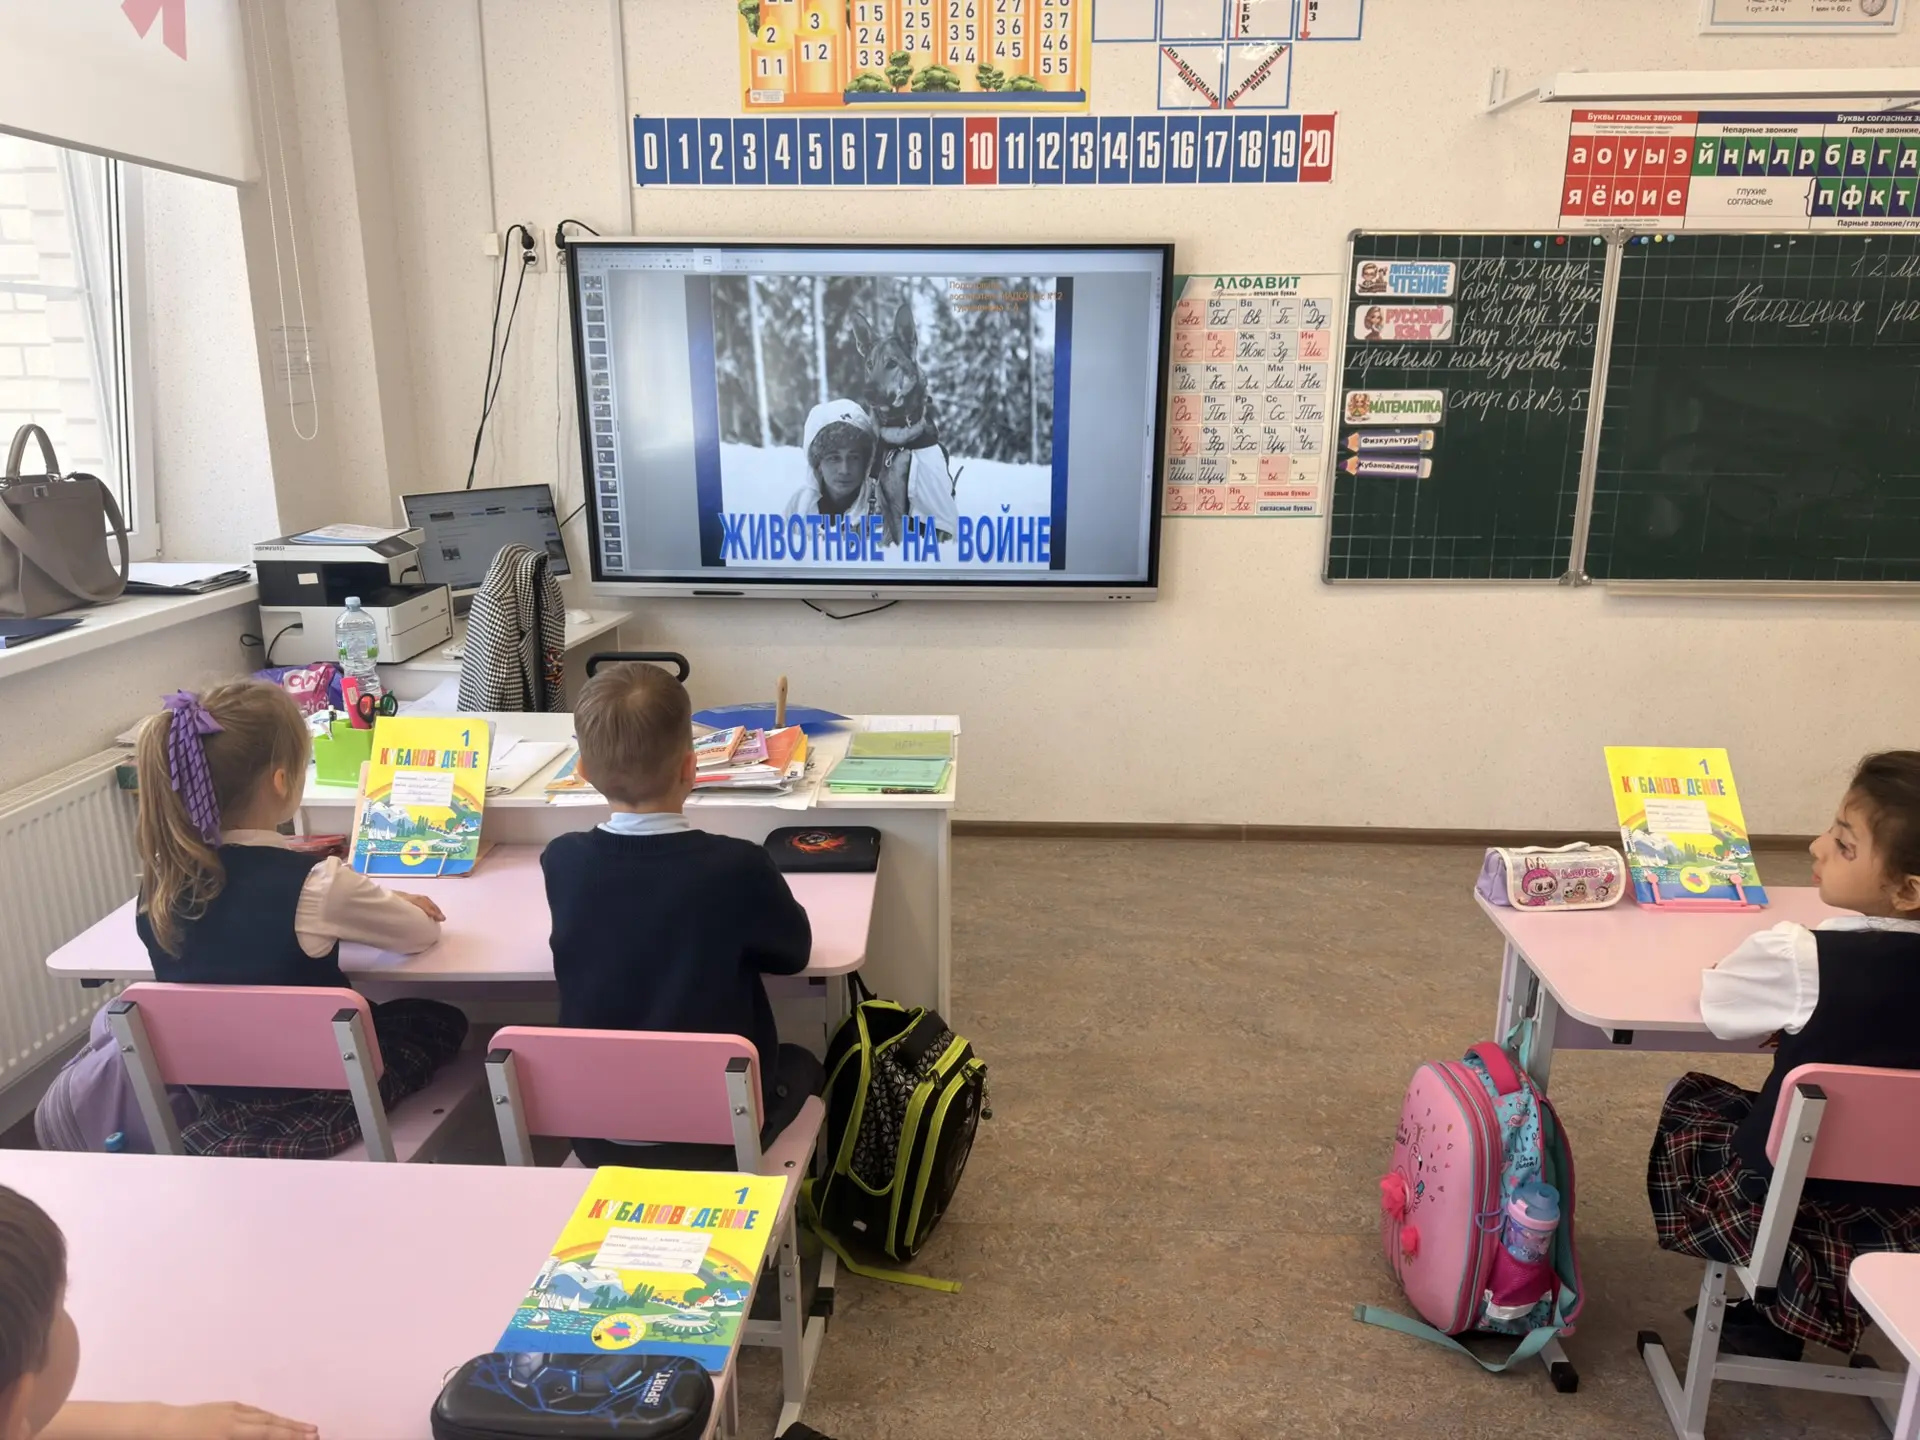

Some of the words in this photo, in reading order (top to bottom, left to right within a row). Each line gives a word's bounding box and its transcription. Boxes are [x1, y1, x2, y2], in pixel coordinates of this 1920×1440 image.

[811, 13, 819, 29] 3
[767, 27, 775, 42] 2
[1240, 46, 1284, 90] ДИАГОНАЛИ
[1178, 59, 1219, 103] ДИАГОНАЛИ
[1250, 70, 1272, 91] ВНИЗ
[1588, 112, 1614, 121] Буквы
[1837, 114, 1865, 123] Буквы
[644, 133, 658, 170] 0
[678, 133, 688, 169] 1
[710, 133, 724, 170] 2
[743, 133, 756, 170] 3
[775, 133, 791, 169] 4
[808, 133, 822, 170] 5
[842, 133, 855, 170] 6
[875, 133, 888, 170] 7
[908, 133, 922, 170] 8
[942, 133, 955, 170] 9
[969, 132, 993, 170] 10
[1005, 132, 1024, 169] 11
[1036, 132, 1060, 169] 12
[1070, 132, 1093, 169] 13
[1102, 132, 1128, 169] 14
[1137, 131, 1160, 169] 15
[1170, 131, 1194, 169] 16
[1205, 131, 1228, 168] 17
[1238, 130, 1262, 168] 18
[1272, 130, 1295, 168] 19
[1303, 129, 1330, 168] 20
[1572, 147, 1587, 164] а
[1597, 148, 1612, 164] о
[1623, 148, 1637, 169] у
[1645, 148, 1665, 164] ы
[1673, 148, 1687, 164] э
[1698, 142, 1714, 164] й
[1723, 149, 1738, 164] н
[1747, 149, 1766, 164] м
[1772, 149, 1789, 164] л
[1799, 149, 1815, 170] р
[1825, 144, 1841, 165] б
[1851, 149, 1866, 164] в
[1877, 149, 1892, 164] г
[1900, 150, 1917, 168] д
[1567, 190, 1582, 205] я
[1592, 185, 1606, 205] ё
[1614, 190, 1634, 205] ю
[1642, 190, 1657, 205] и
[1667, 189, 1682, 205] е
[1727, 198, 1773, 207] согласные
[1736, 188, 1767, 197] глухие
[1819, 190, 1834, 205] п
[1841, 184, 1862, 210] ф
[1870, 190, 1885, 205] к
[1896, 190, 1910, 206] т
[1390, 264, 1450, 275] ЛИТЕРАТУРНОЕ
[1511, 260, 1537, 280] 32
[1214, 277, 1301, 289] АЛФАВИТ
[1389, 275, 1448, 294] ЧТЕНИЕ
[1725, 283, 1865, 323] Классная
[1385, 305, 1444, 324] РУССКИЙ
[1558, 302, 1586, 325] 41
[1394, 324, 1432, 339] ЯЗЫК
[1505, 324, 1534, 346] 82
[1580, 323, 1594, 345] 3
[1350, 344, 1442, 378] правило
[1368, 400, 1442, 414] МАТЕМАТИКА
[1507, 389, 1536, 411] 68
[1362, 437, 1418, 445] Физкультура
[718, 512, 884, 561] ЖИВОТНЫЕ
[902, 515, 941, 562] НА
[958, 503, 1051, 562] ВОЙНЕ
[461, 730, 470, 747] 1
[380, 748, 479, 769] КУБАНОВЕДЕНИЕ
[1699, 759, 1710, 775] 1
[1622, 776, 1726, 796] КУБАНОВЕДЕНИЕ
[734, 1187, 749, 1205] 1
[588, 1199, 759, 1230] КУБАНОВЕДЕНИЕ
